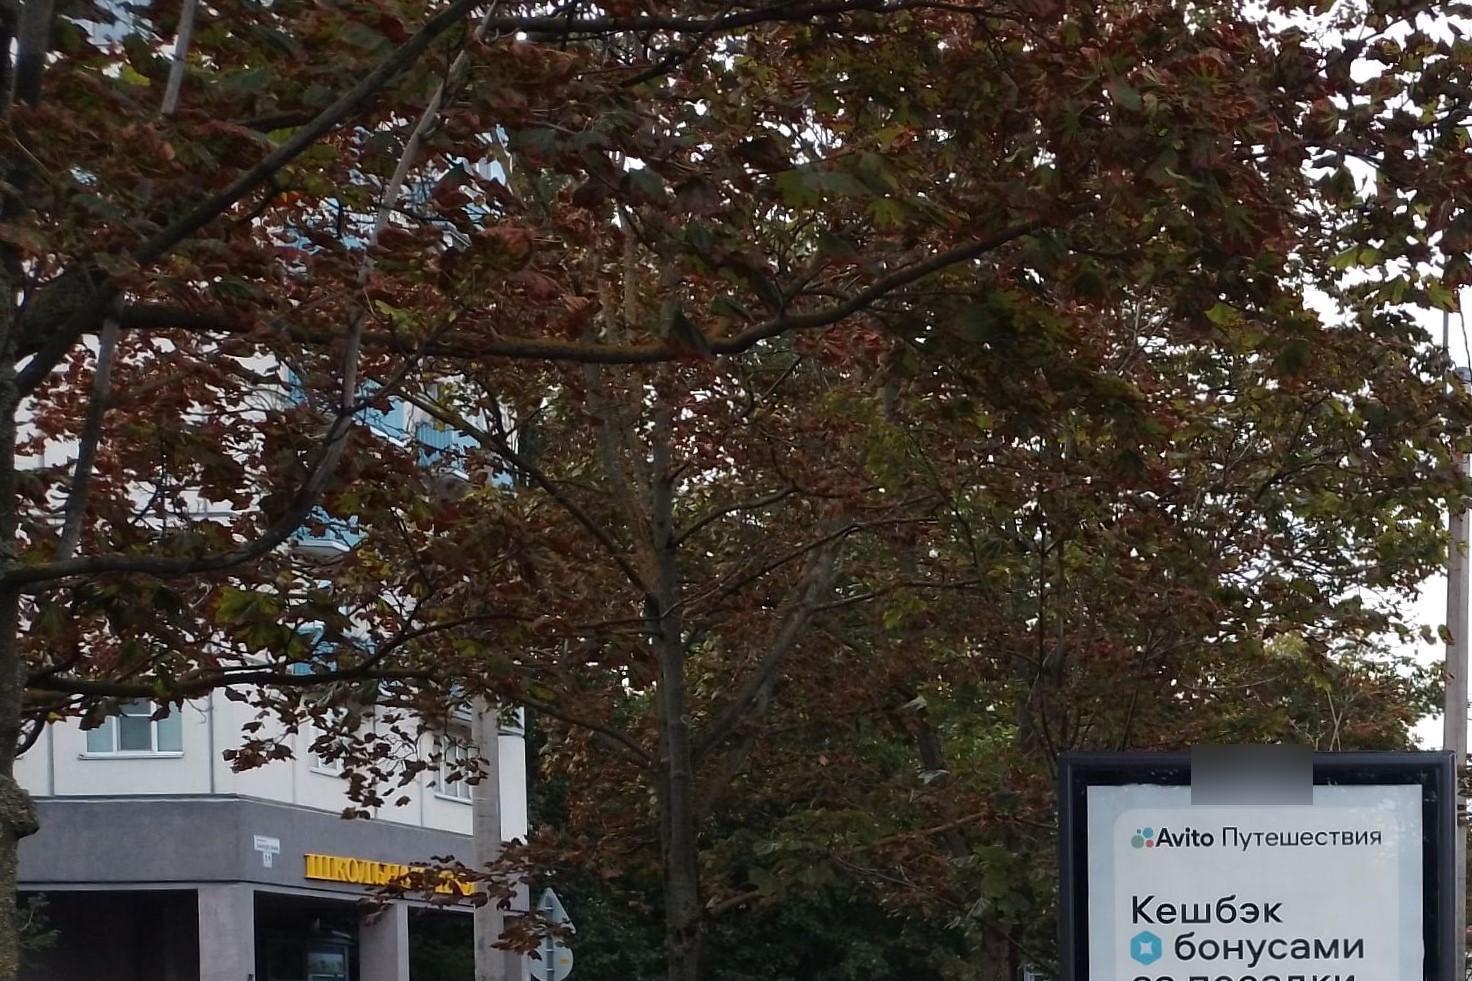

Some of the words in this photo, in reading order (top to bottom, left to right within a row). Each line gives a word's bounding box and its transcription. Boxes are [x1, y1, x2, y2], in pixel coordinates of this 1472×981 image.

[1155, 827, 1215, 848] Avito
[1222, 826, 1382, 852] Путешествия
[1132, 894, 1283, 925] Кешбэк
[1174, 931, 1364, 969] бонусами
